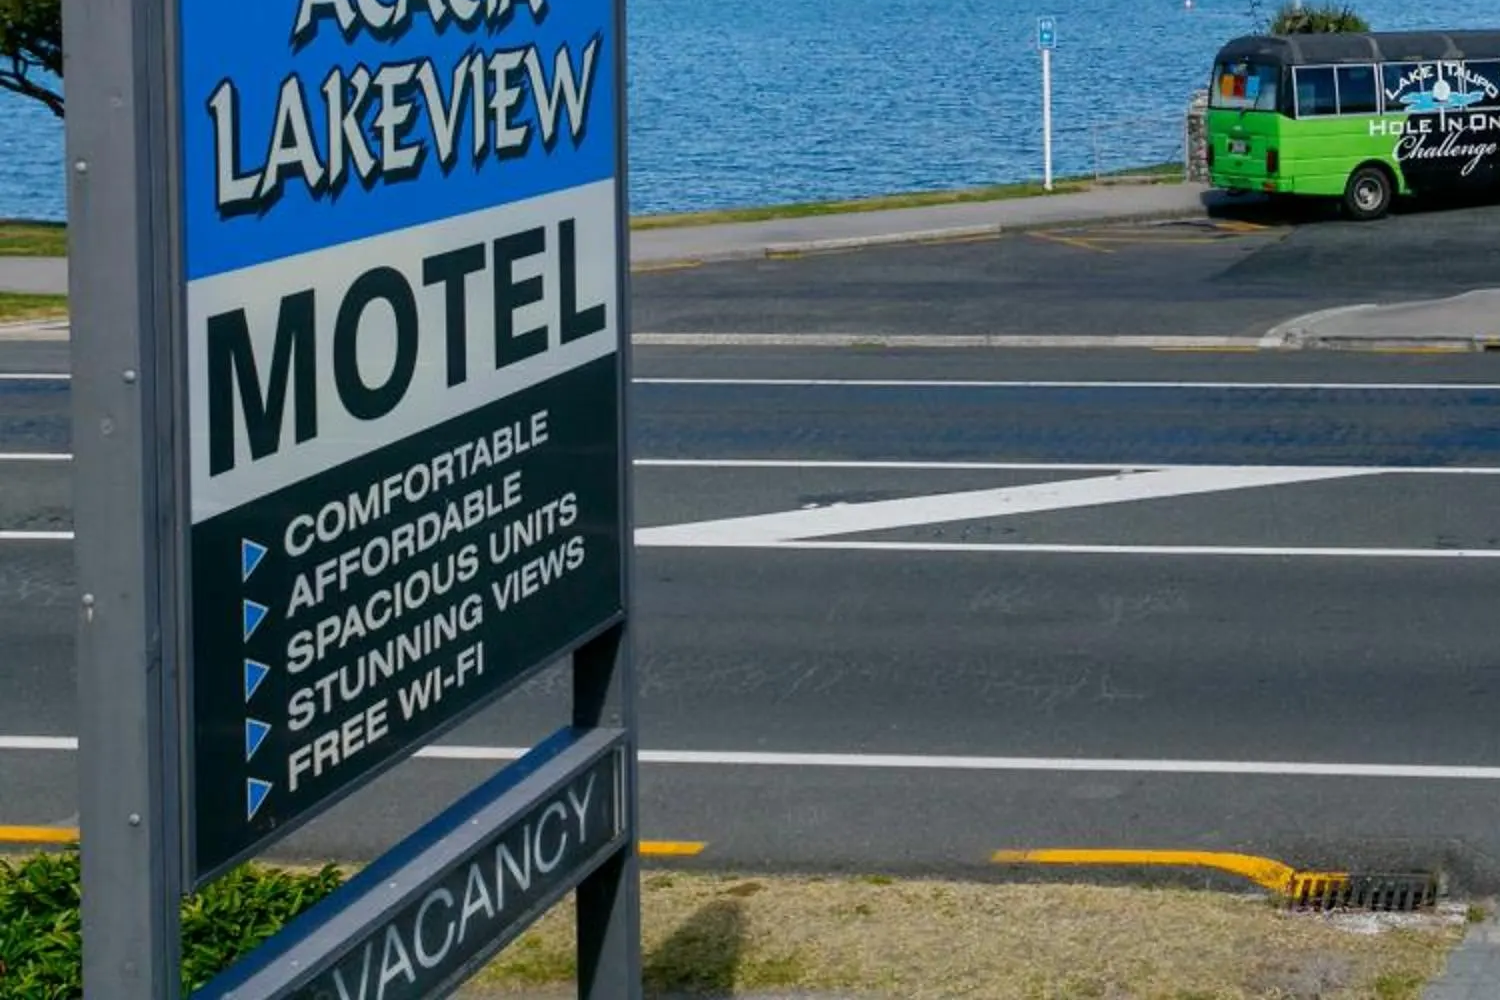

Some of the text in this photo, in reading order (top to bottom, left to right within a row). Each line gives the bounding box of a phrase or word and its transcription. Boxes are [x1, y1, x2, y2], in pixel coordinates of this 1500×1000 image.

[207, 34, 602, 217] LAKEVIEW
[1369, 119, 1433, 136] HOLE
[1440, 106, 1463, 132] IN
[1385, 62, 1499, 100] LAKE TAUPO
[1392, 127, 1498, 176] Challenge
[207, 217, 607, 477] MOTEL
[283, 410, 550, 557] COMFORTABLE
[285, 471, 523, 618] AFFORDABLE
[286, 493, 579, 674] SPACIOUS UNITS
[287, 535, 586, 732] STUNNING VIEWS
[288, 642, 485, 792] FREE WI-FI
[332, 773, 598, 1000] VACANCY
